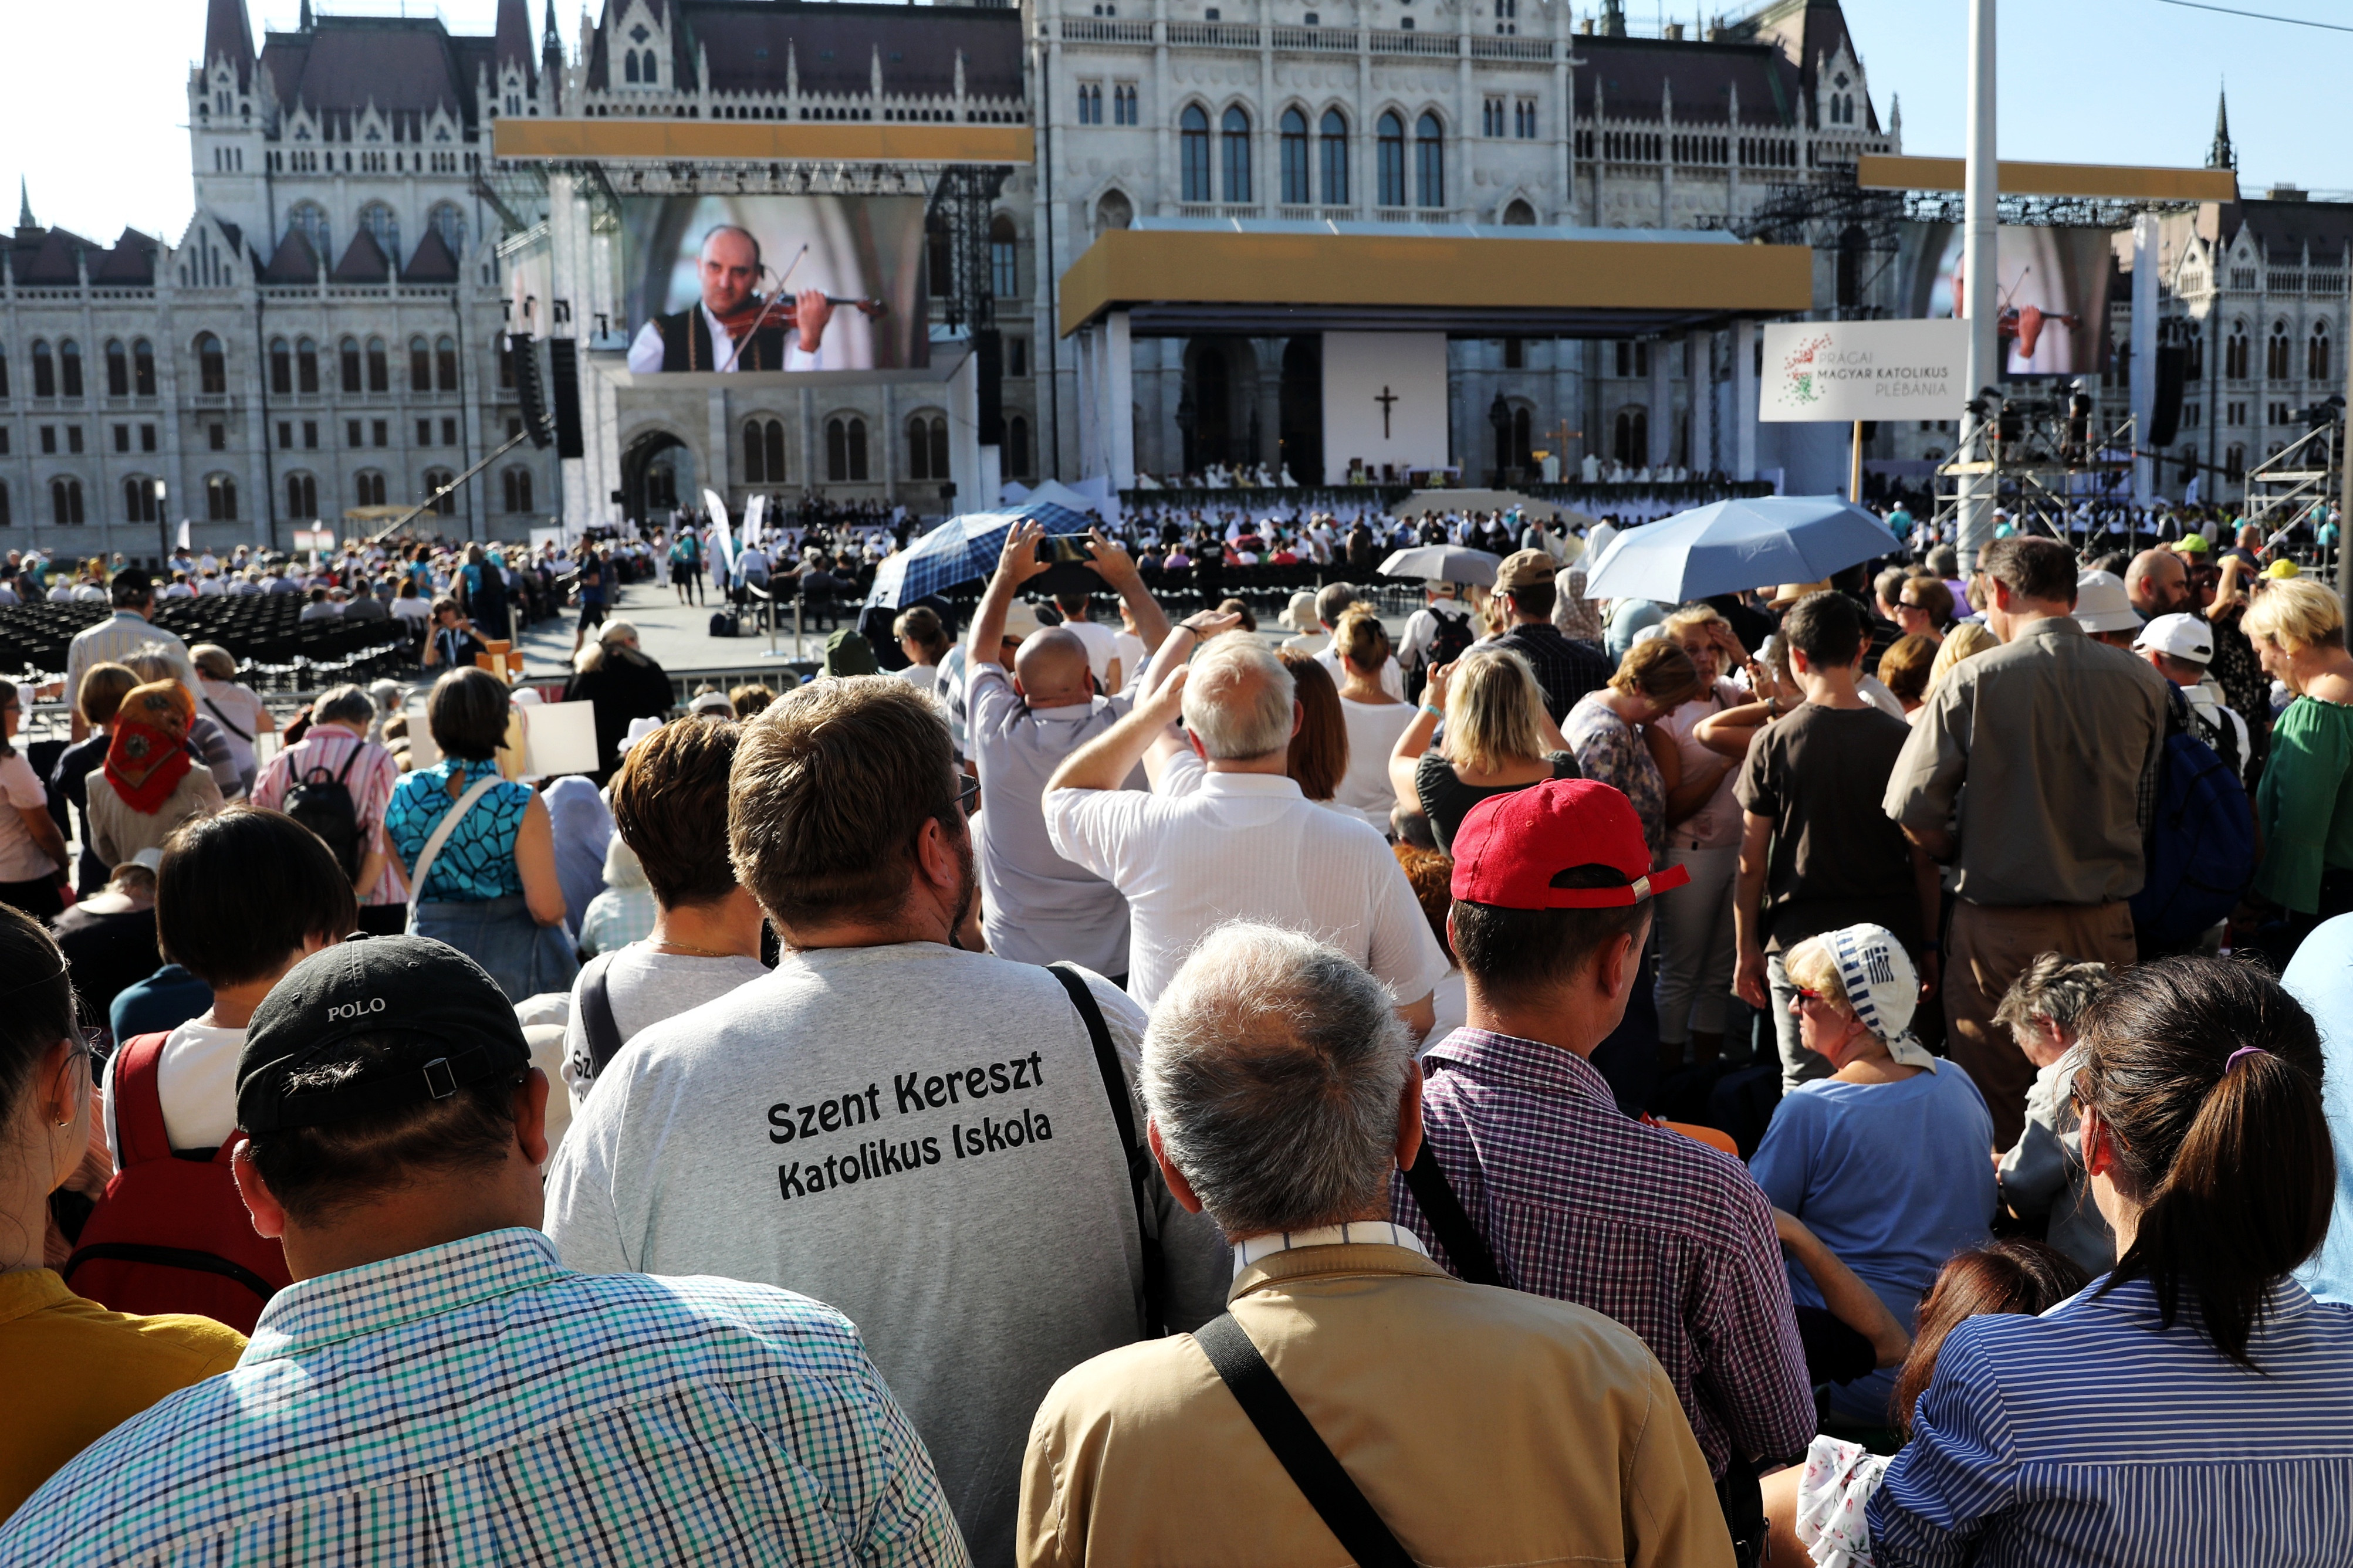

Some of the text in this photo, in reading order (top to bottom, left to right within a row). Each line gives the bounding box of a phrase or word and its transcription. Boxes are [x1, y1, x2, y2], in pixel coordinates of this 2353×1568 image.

[1817, 366, 1948, 380] MAGYAR KATOLIKUS
[1875, 381, 1947, 397] PLÉBÁNIA
[327, 998, 386, 1022] POLO
[768, 1051, 1044, 1144] Szent Kereszt
[778, 1108, 1053, 1200] Katolikus Iskola
